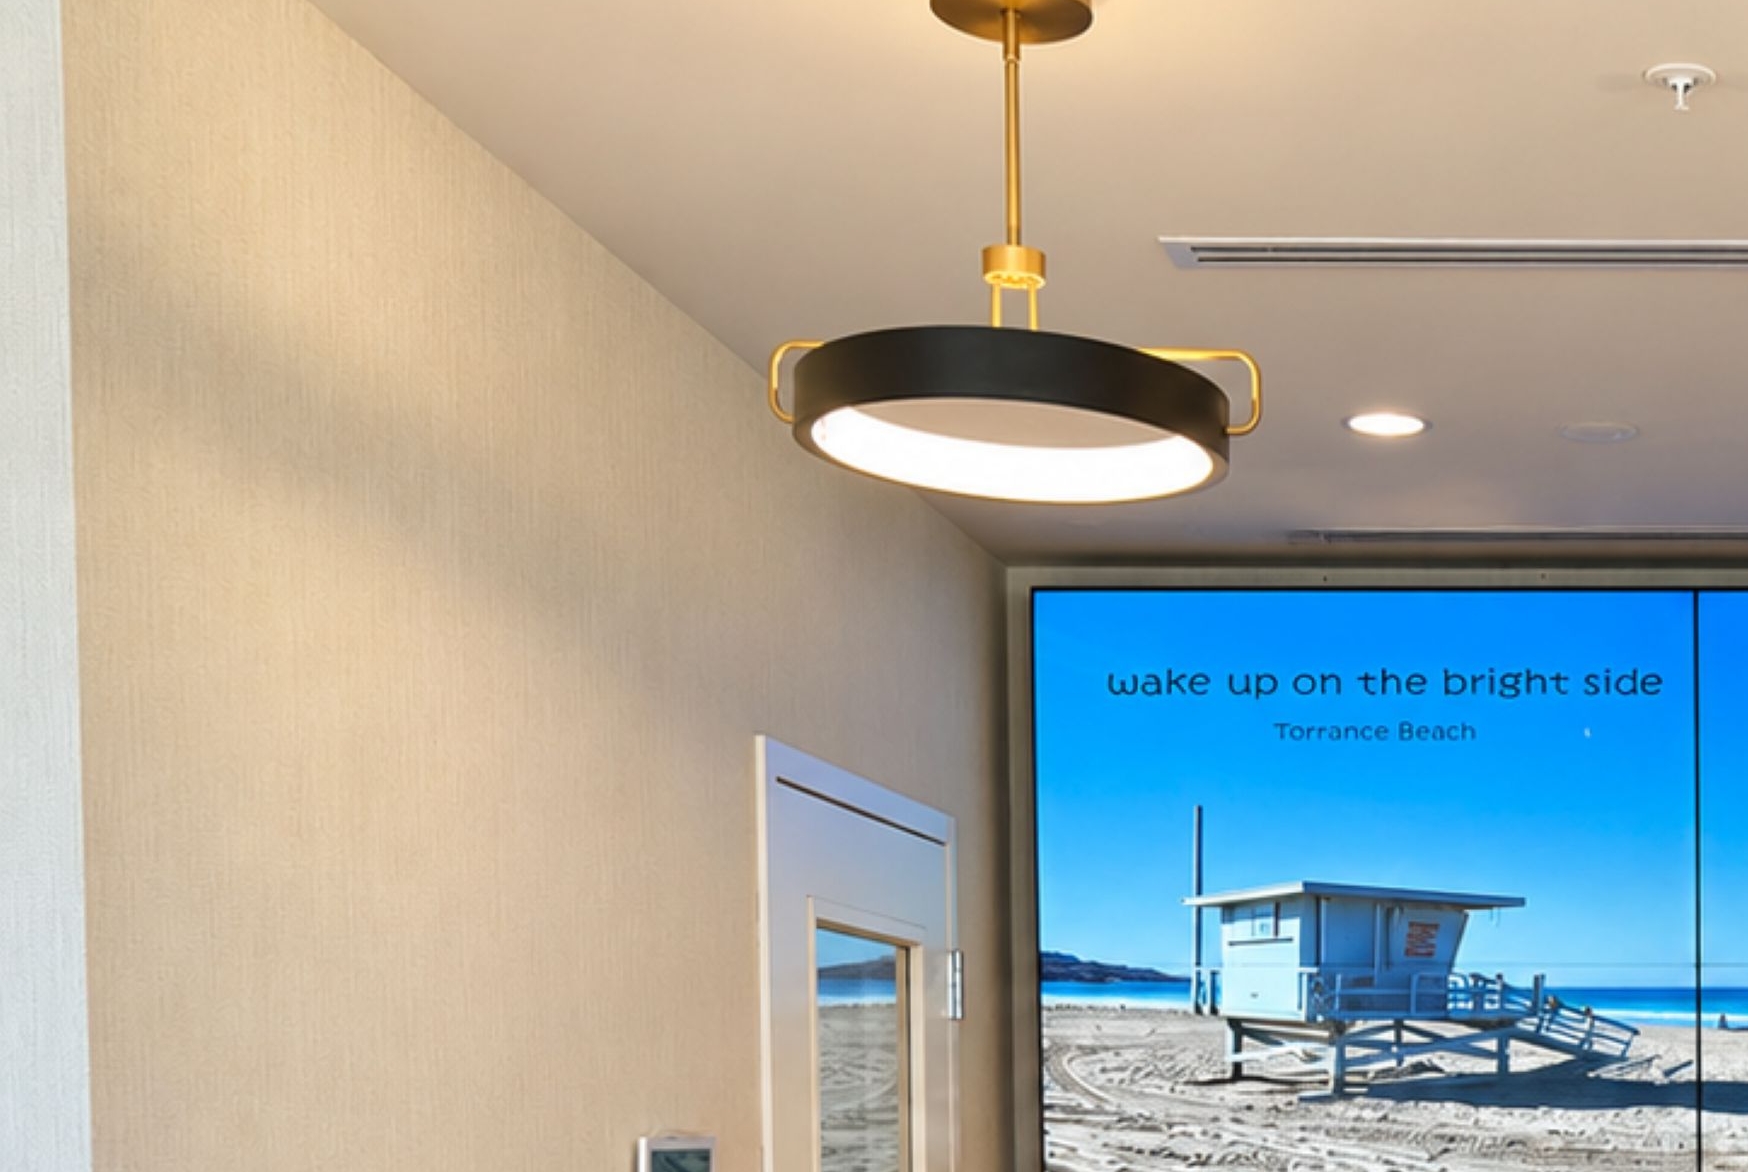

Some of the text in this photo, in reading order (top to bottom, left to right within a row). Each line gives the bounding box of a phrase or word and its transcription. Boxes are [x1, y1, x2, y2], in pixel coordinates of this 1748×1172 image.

[1106, 666, 1663, 700] wake up on the bright side
[1273, 720, 1477, 742] Torrance Beach
